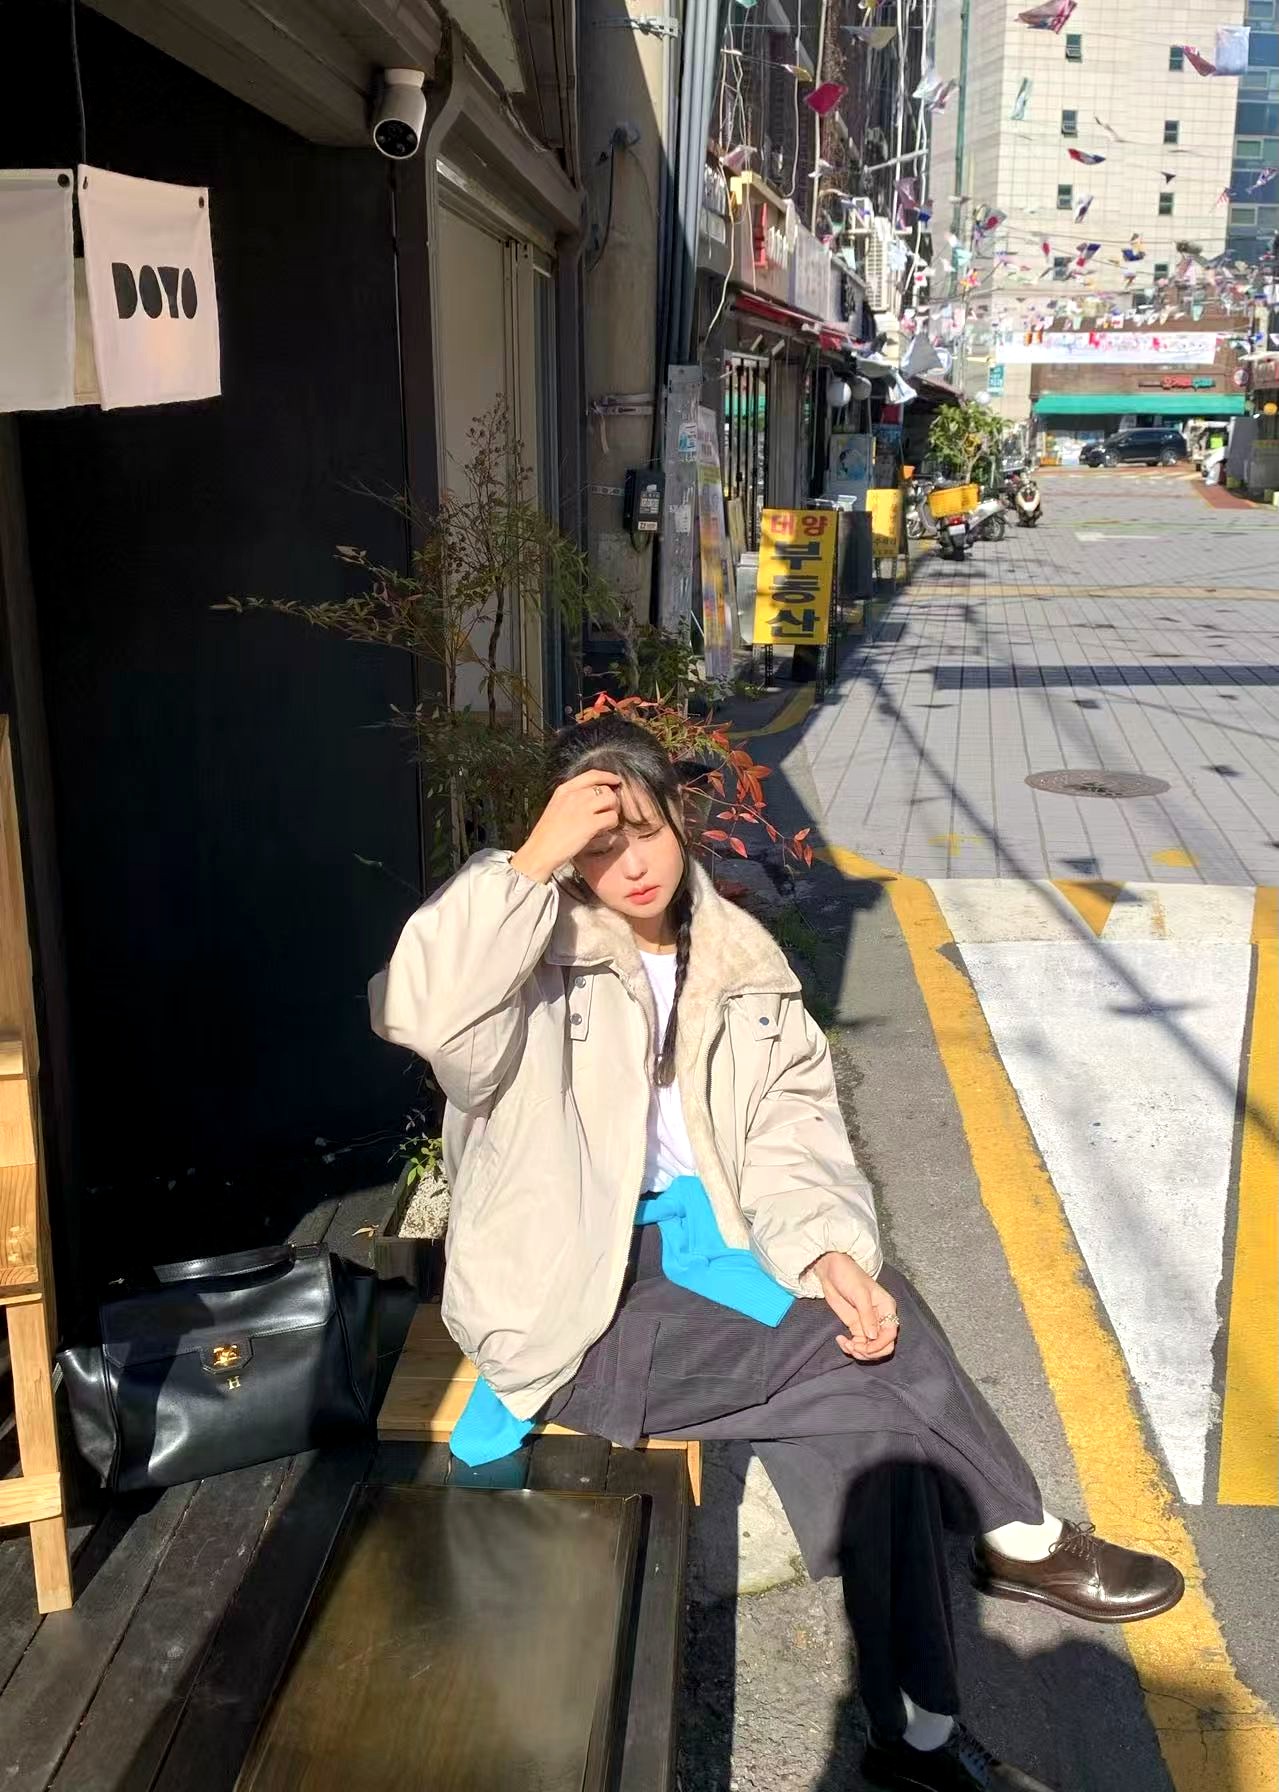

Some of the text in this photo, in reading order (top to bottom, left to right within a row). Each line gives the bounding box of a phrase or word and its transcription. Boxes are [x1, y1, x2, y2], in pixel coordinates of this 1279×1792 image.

[111, 262, 198, 320] DOYO
[770, 514, 828, 537] 태양
[765, 541, 822, 638] 부동산
[227, 1375, 241, 1390] H
